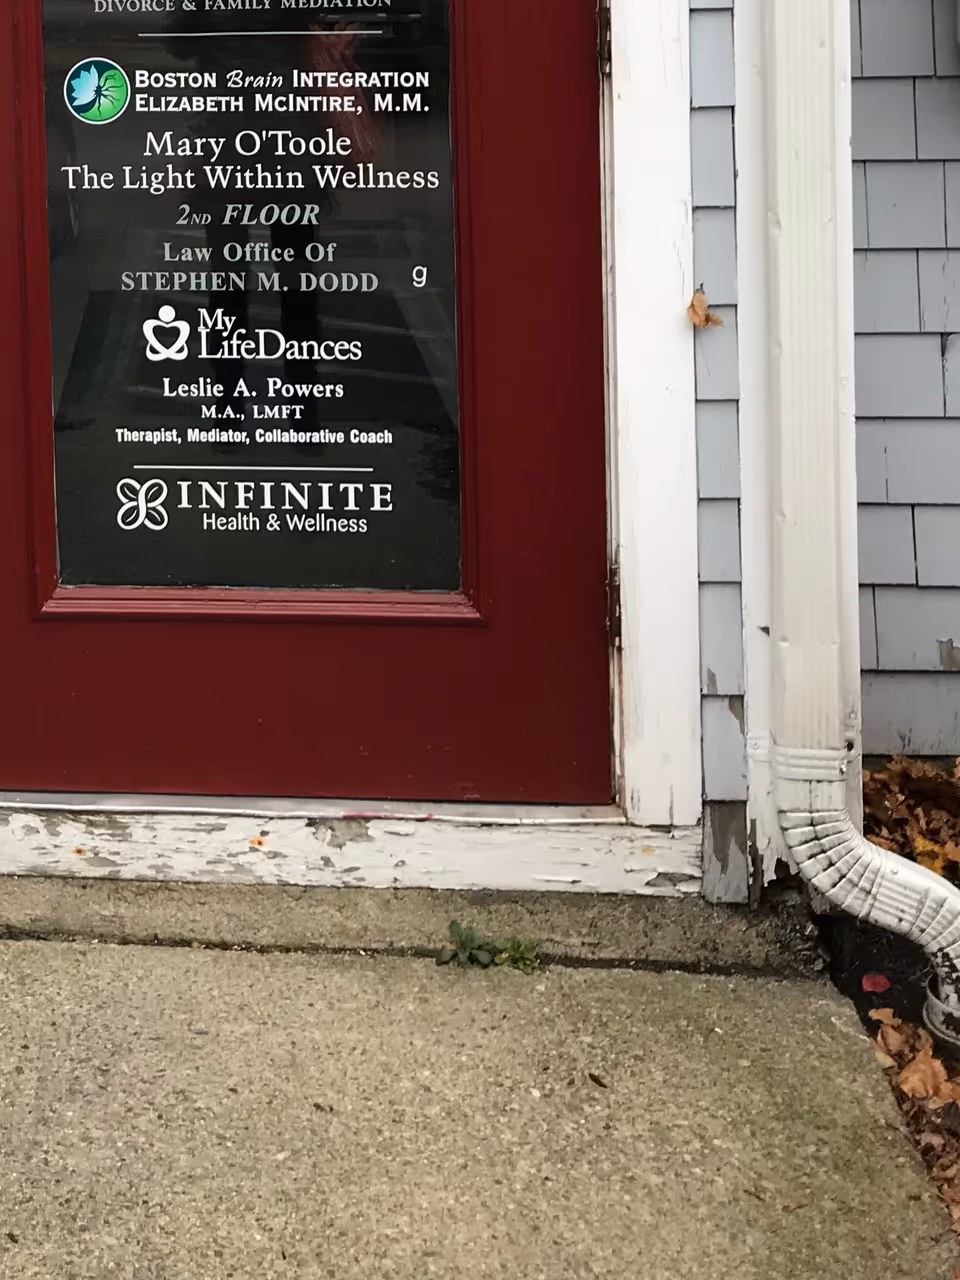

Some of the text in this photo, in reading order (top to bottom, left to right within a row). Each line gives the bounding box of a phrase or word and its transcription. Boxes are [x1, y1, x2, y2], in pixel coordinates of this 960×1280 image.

[135, 69, 430, 88] BOSTON Brain INTEGRATION
[135, 93, 244, 112] ELIZABETH
[374, 94, 430, 112] M.M.
[143, 128, 352, 162] Mary O'Toole
[61, 163, 440, 195] The Light Within Wellness
[222, 204, 320, 226] FLOOR
[163, 242, 337, 262] Law Office Of
[121, 271, 379, 292] STEPHEN M. DODD
[411, 265, 428, 288] g
[198, 308, 236, 335] My
[198, 328, 362, 361] LifeDances
[162, 377, 344, 398] Leslie A. Powers
[201, 405, 305, 421] M.A., LMFT
[115, 428, 393, 445] Therapist, Mediator, Collaborative Coach
[177, 480, 394, 511] INFINITE
[203, 511, 368, 533] Health & Wellness
